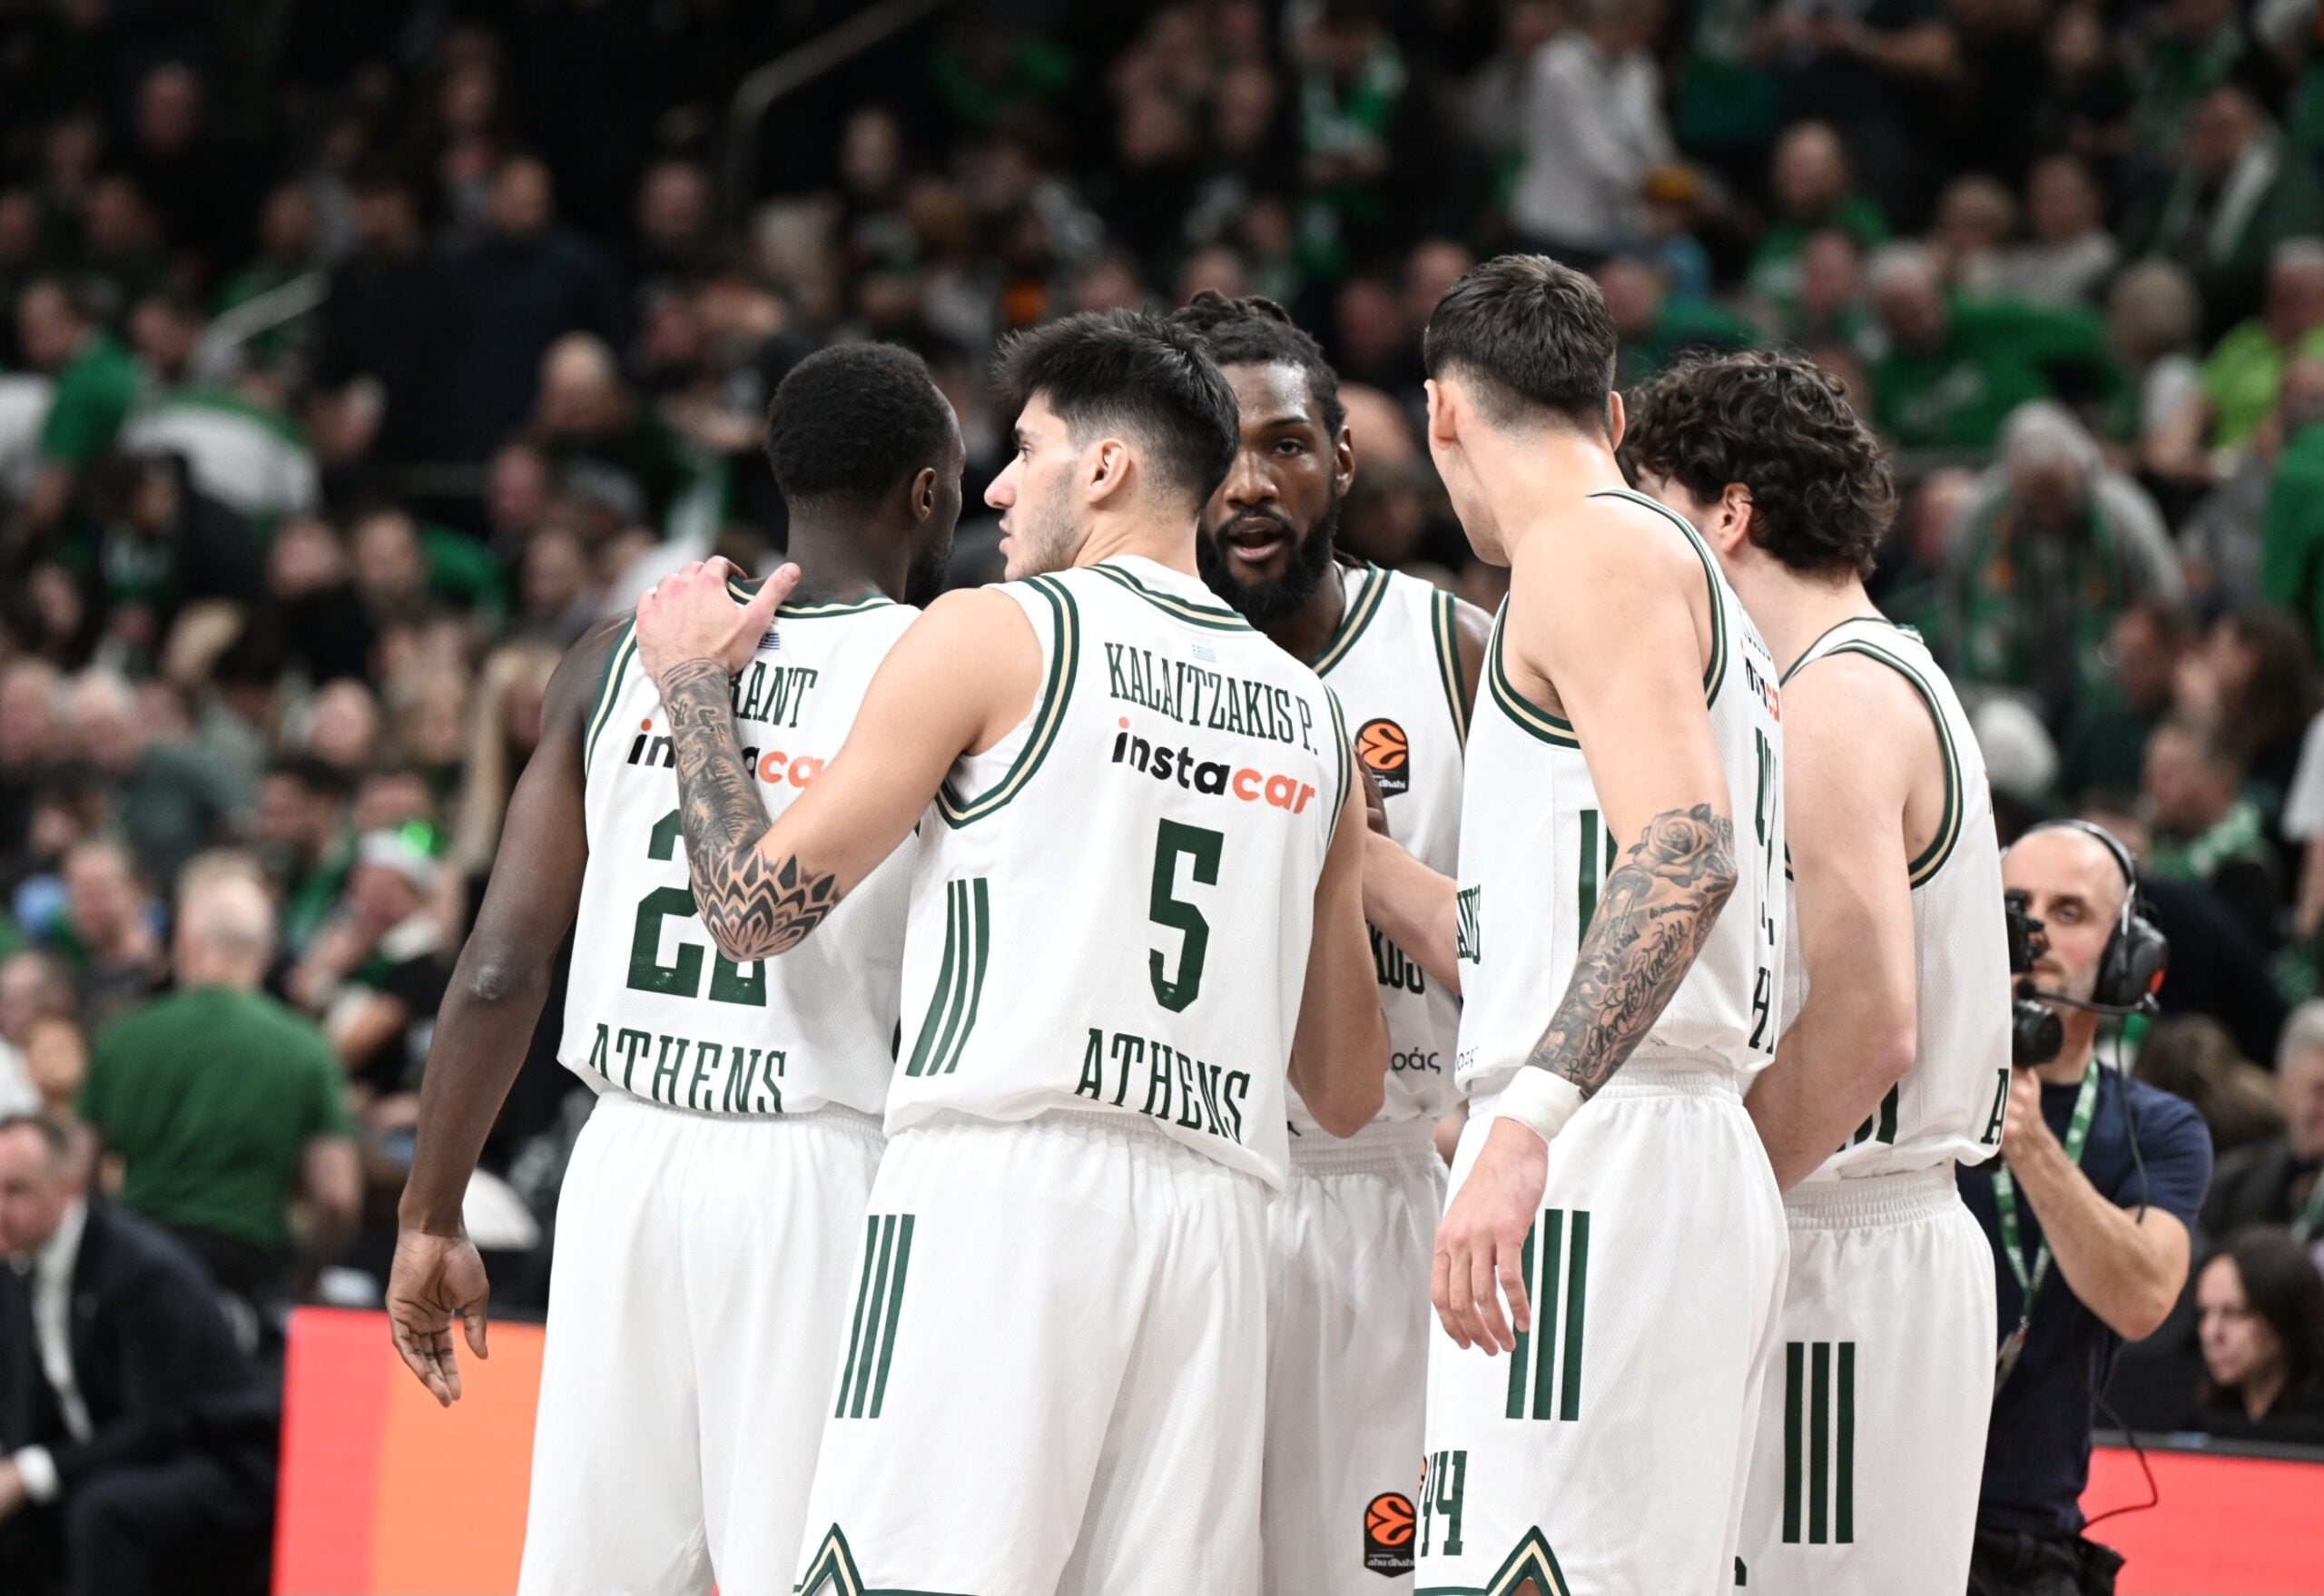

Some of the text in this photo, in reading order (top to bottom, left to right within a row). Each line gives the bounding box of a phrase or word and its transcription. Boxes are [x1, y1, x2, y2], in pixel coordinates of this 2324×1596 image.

[1104, 642, 1318, 755] KALAITZAKIS P.
[1110, 715, 1316, 814] instacar
[1148, 817, 1225, 1014] 5
[588, 1022, 787, 1114] ATHENS
[1073, 1027, 1251, 1146] ATHENS
